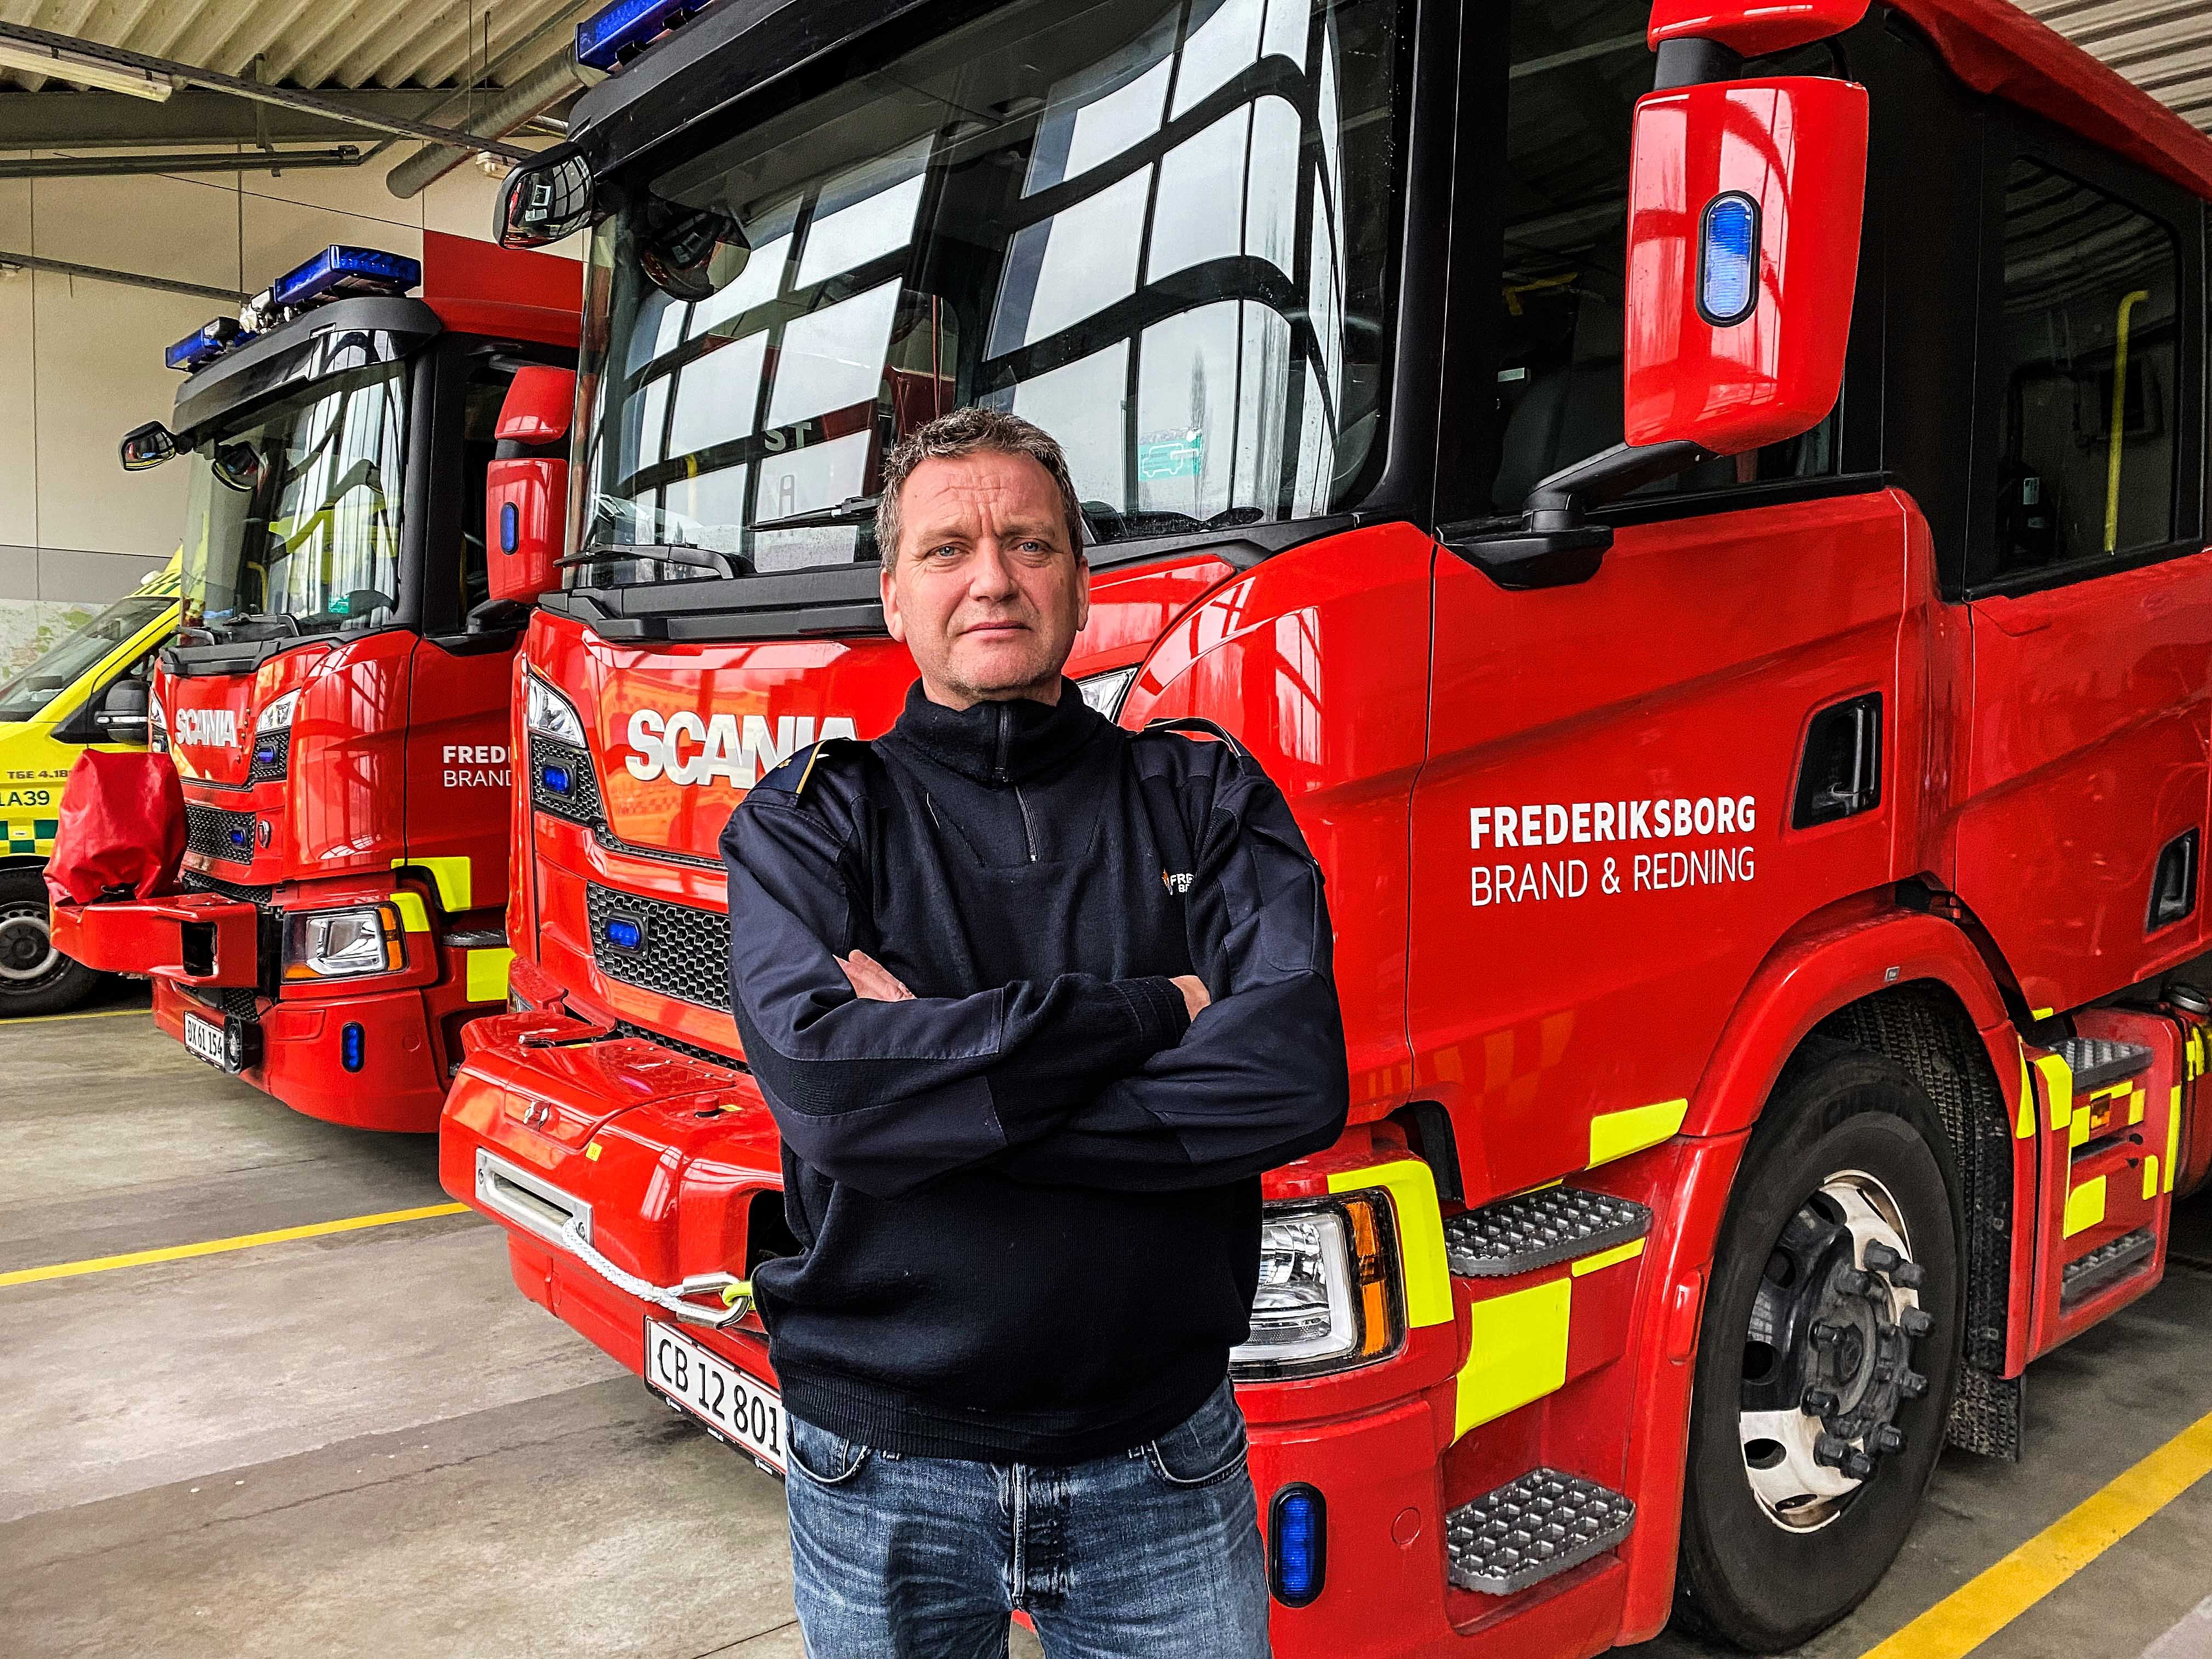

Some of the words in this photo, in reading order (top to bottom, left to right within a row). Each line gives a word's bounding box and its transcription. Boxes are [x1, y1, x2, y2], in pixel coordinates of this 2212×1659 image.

[175, 708, 237, 748] SCANIA
[7, 771, 34, 779] TGE
[38, 770, 72, 778] 4.18
[443, 746, 510, 763] FRED
[1470, 795, 1756, 849] FREDERIKSBORG
[1471, 859, 1588, 906] BRAND
[1601, 857, 1621, 894] &
[1633, 846, 1754, 891] REDNING
[658, 1339, 689, 1392] CB
[698, 1362, 725, 1421] 12
[733, 1384, 781, 1457] 801
